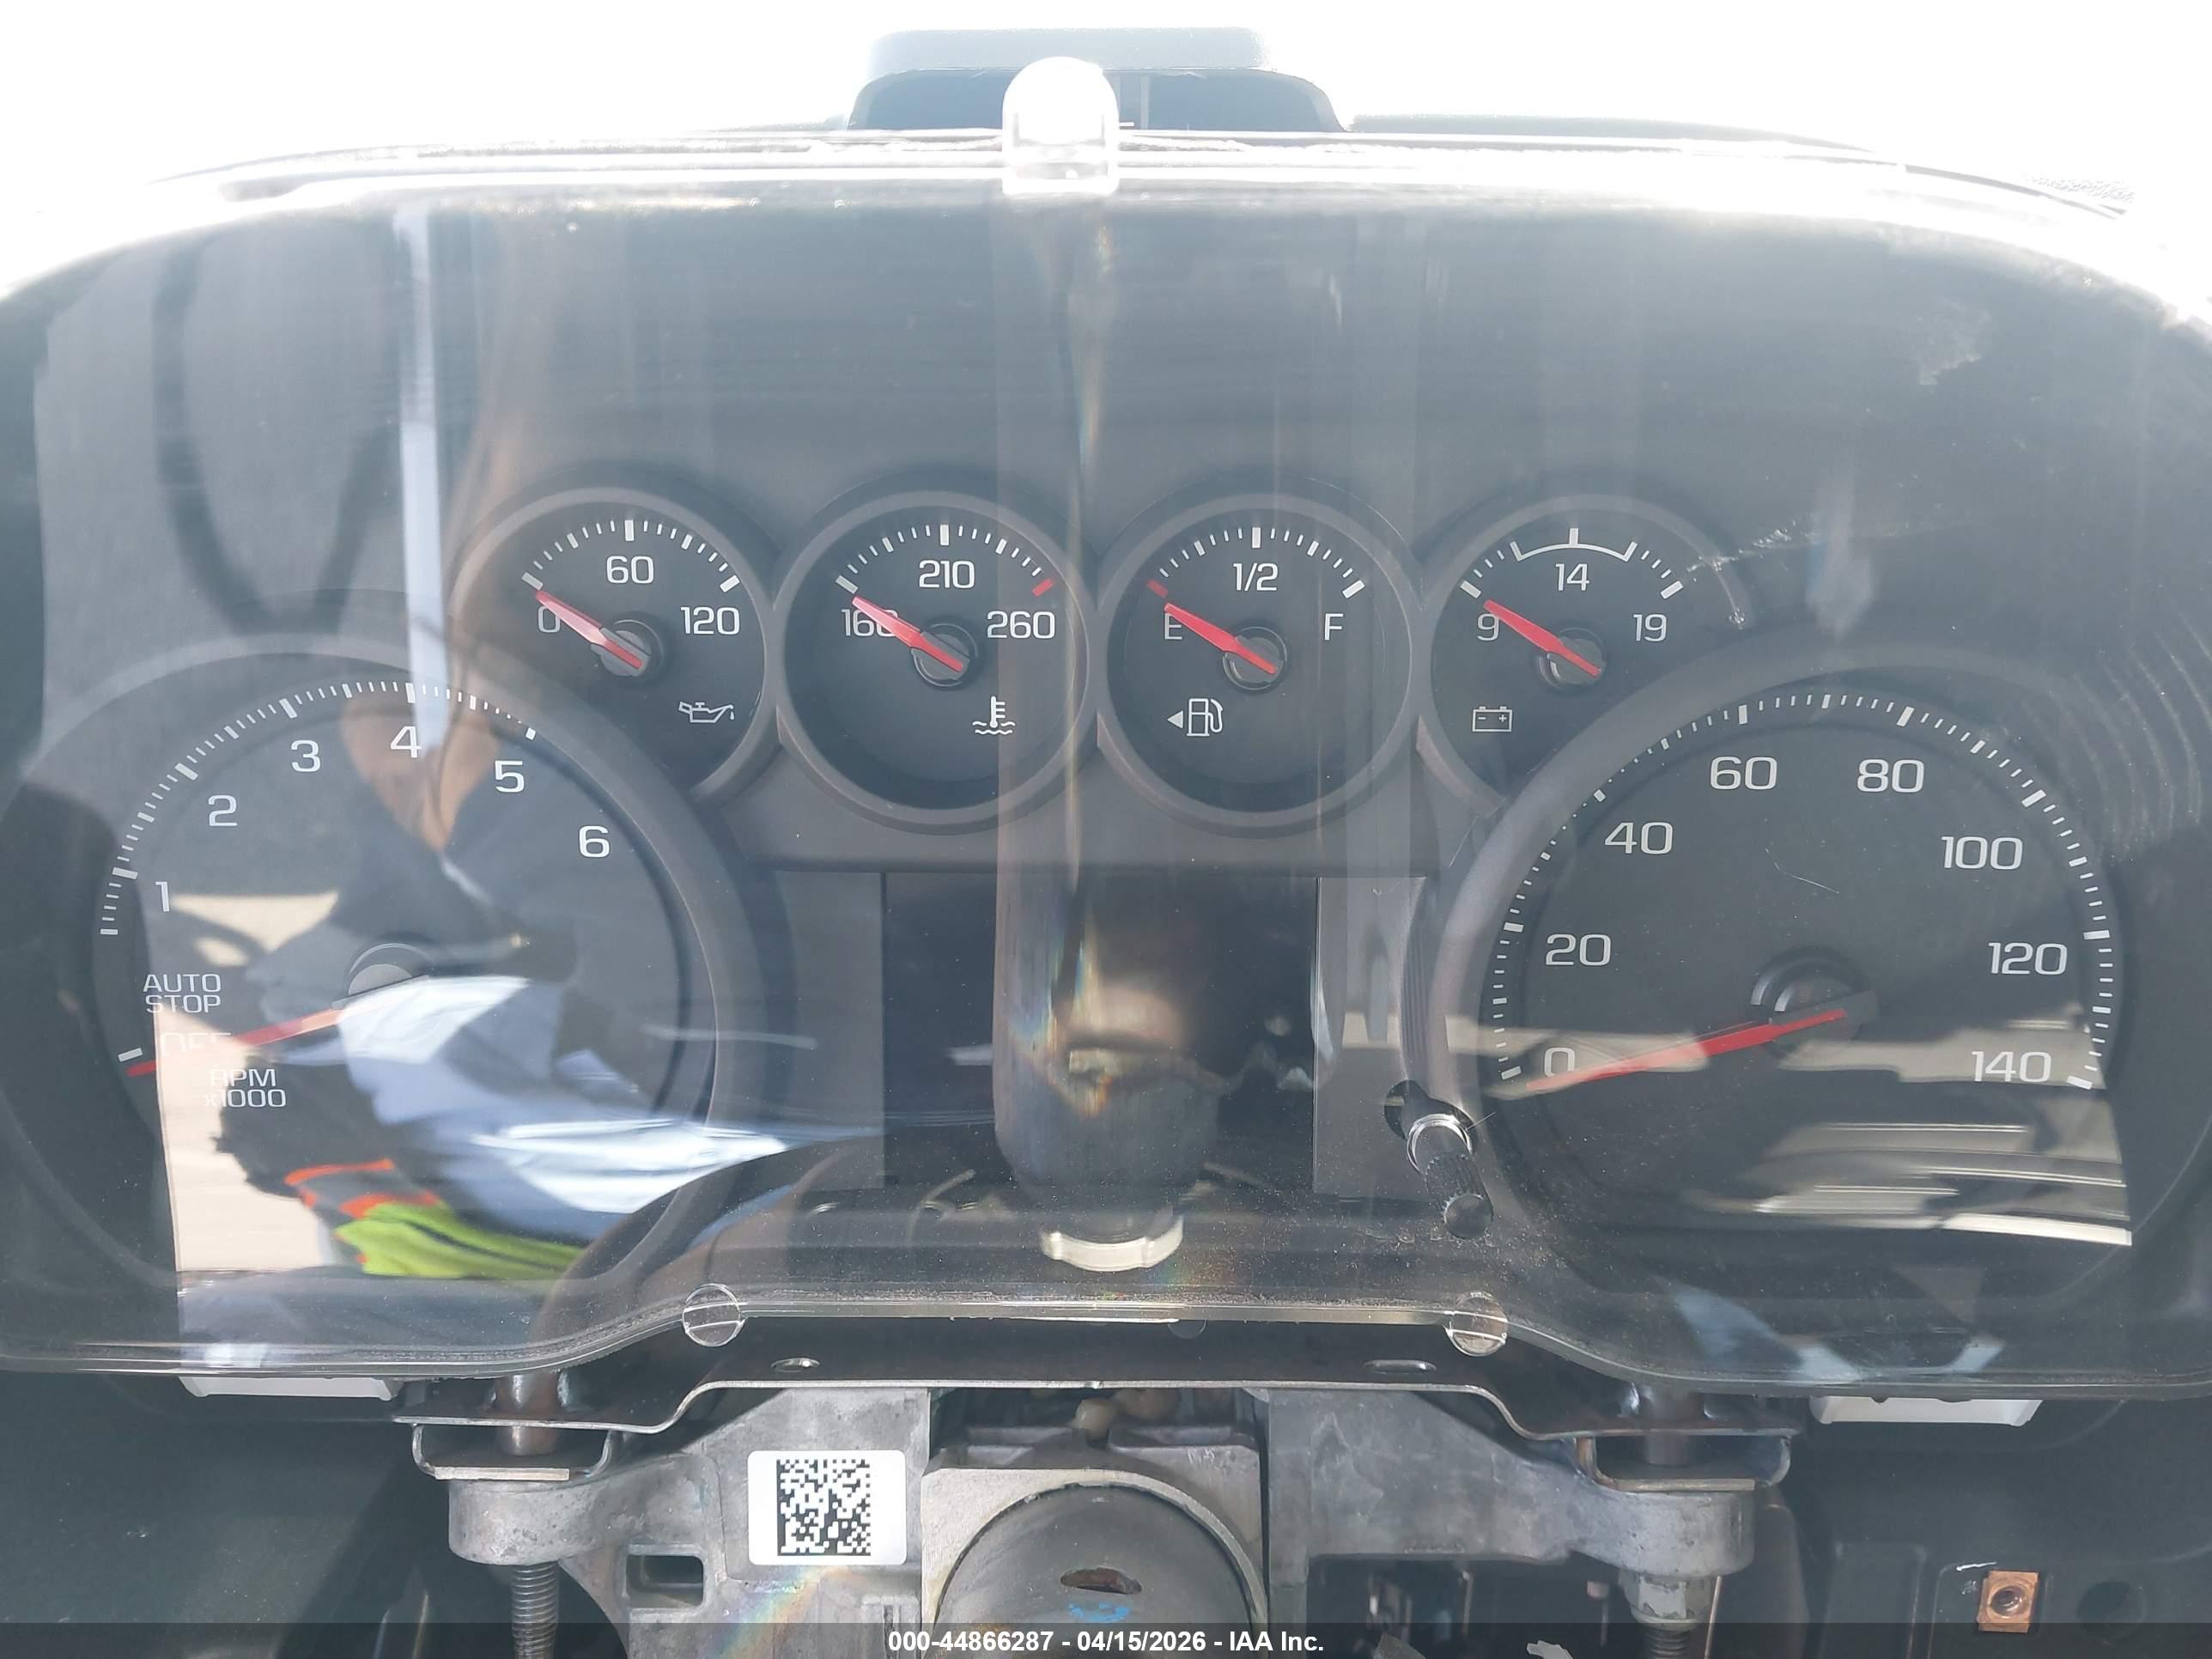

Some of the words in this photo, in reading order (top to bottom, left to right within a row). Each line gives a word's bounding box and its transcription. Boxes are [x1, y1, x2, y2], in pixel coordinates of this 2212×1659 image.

[605, 556, 654, 584] 60
[918, 560, 975, 589] 210
[1232, 562, 1279, 592] 1/2
[1555, 563, 1589, 591] 14
[538, 605, 561, 633] 0
[681, 606, 740, 635] 120
[987, 611, 1055, 639] 260
[1164, 612, 1183, 641] E
[1323, 612, 1344, 641] F
[1476, 613, 1500, 641] 9
[1633, 613, 1668, 642] 19
[290, 739, 321, 773] 3
[390, 726, 421, 758] 4
[495, 759, 526, 793] 5
[1710, 756, 1778, 791] 60
[1856, 759, 1925, 794] 80
[207, 794, 238, 827] 2
[578, 825, 611, 859] 6
[1604, 821, 1674, 855] 40
[1941, 836, 2023, 871] 100
[155, 881, 170, 913] 1
[1546, 933, 1612, 967] 20
[1988, 942, 2068, 975] 120
[143, 973, 222, 993] AUTO
[145, 994, 222, 1013] STOP
[210, 1068, 276, 1087] RPM
[1544, 1047, 1577, 1079] 0
[1972, 1050, 2051, 1084] 140
